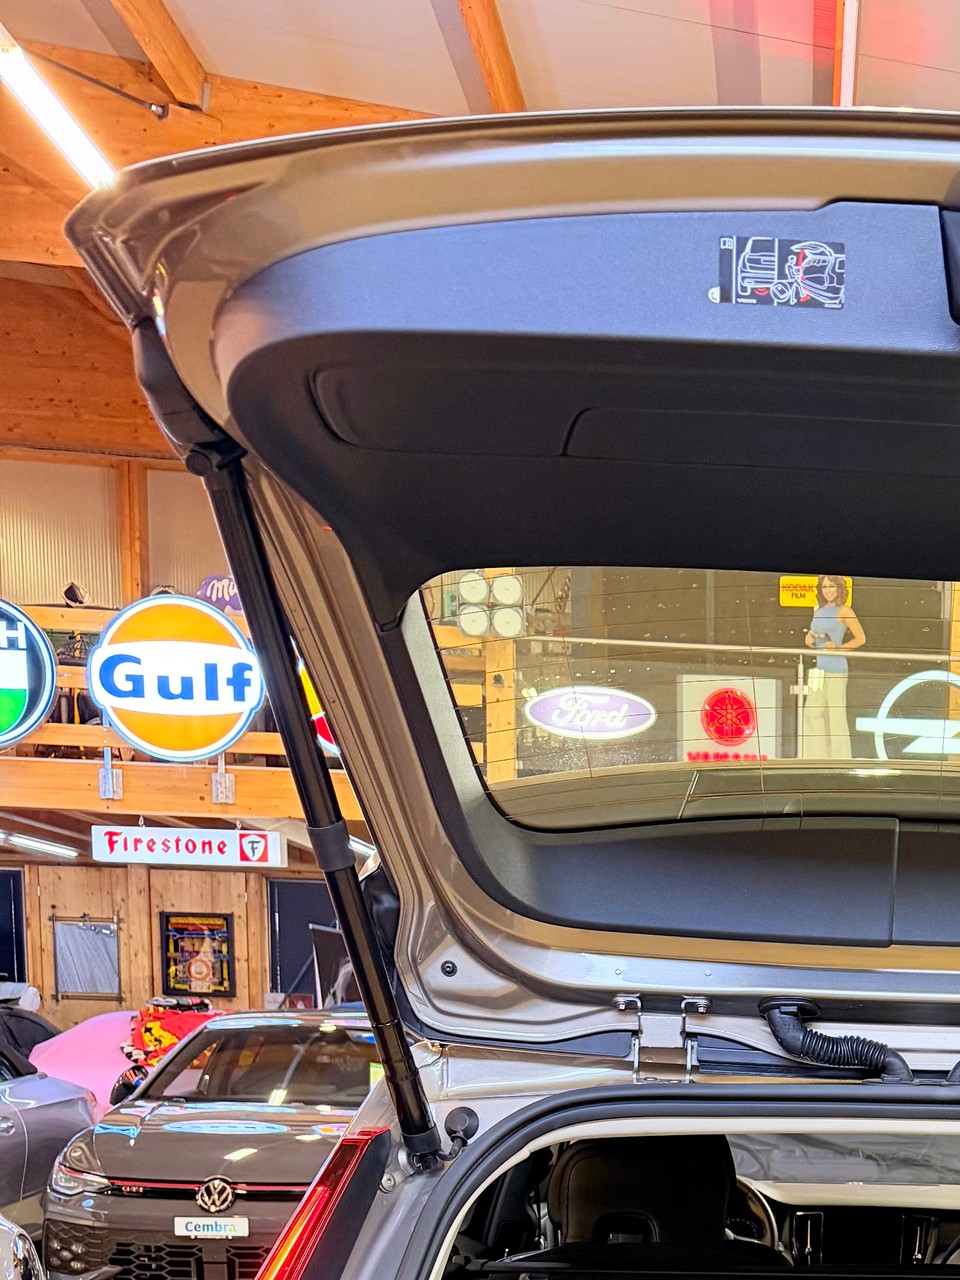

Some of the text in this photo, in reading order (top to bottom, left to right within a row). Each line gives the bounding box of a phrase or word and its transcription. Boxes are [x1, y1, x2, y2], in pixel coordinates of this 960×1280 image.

[782, 583, 814, 592] KODAK
[99, 653, 253, 702] Gulf
[552, 694, 628, 728] Ford
[103, 830, 228, 855] Firestone
[184, 1221, 237, 1232] Cembra
